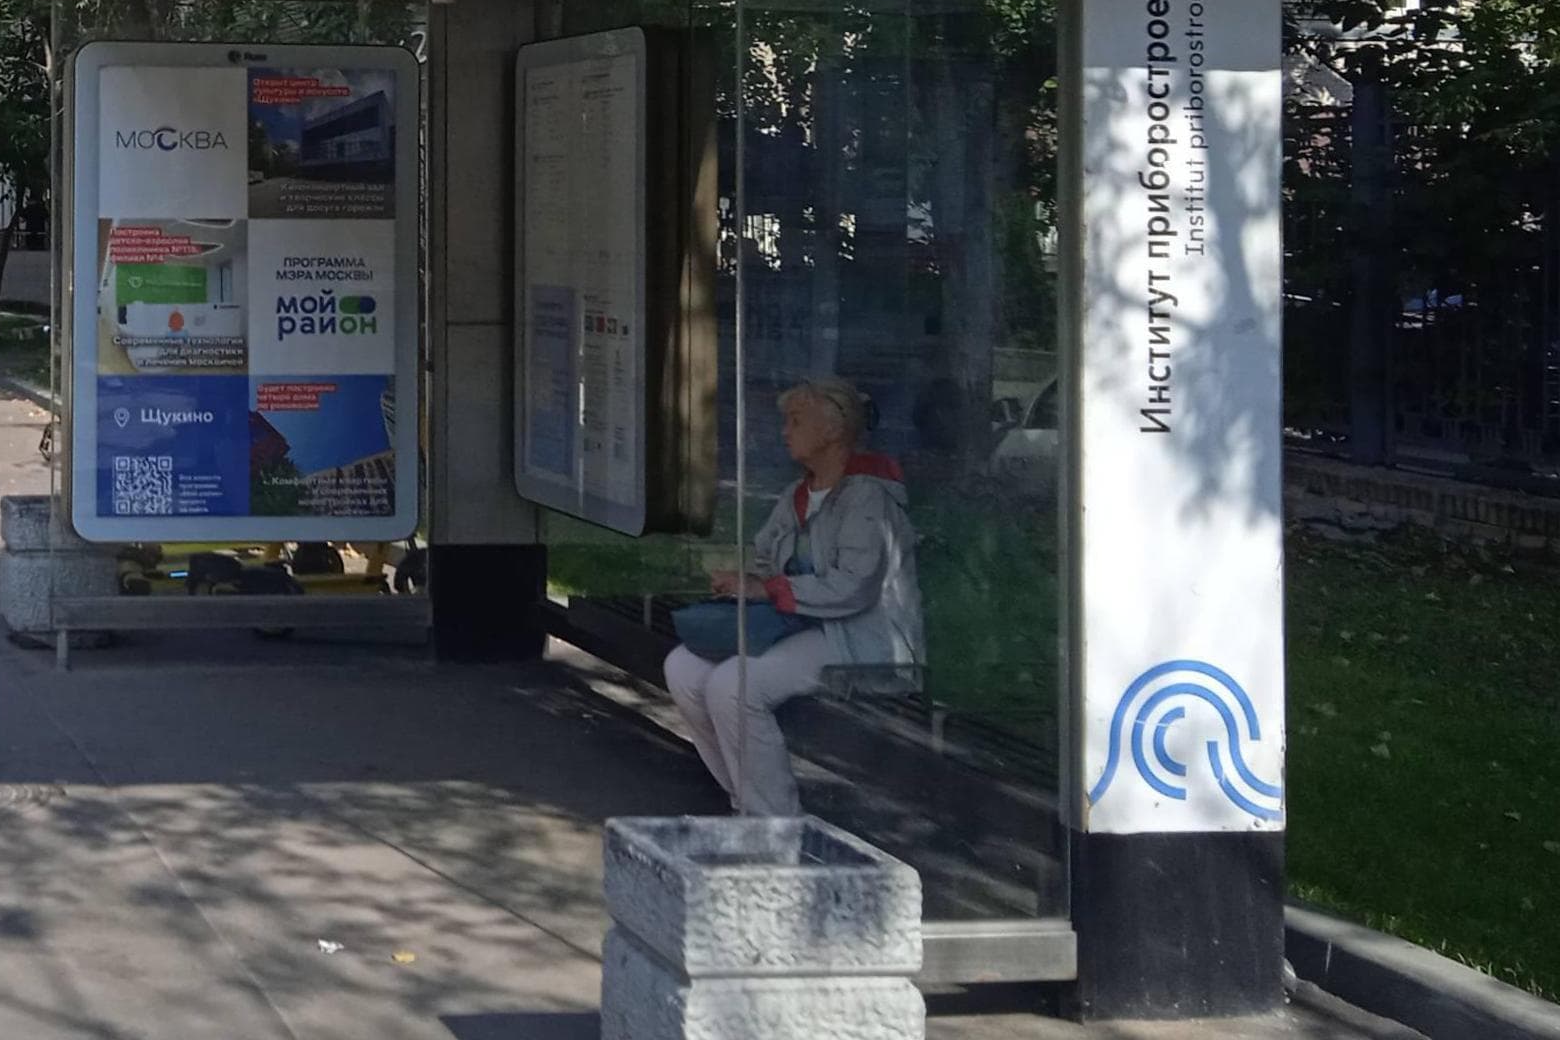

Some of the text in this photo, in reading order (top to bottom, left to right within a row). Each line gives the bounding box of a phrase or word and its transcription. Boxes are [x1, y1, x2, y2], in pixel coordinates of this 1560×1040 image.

[115, 126, 229, 151] МОСКВА
[1184, 159, 1206, 256] Institut
[283, 256, 366, 268] ПРОГРАММА
[276, 269, 374, 281] МЭРА МОСКВЫ
[276, 288, 337, 315] мой
[1141, 264, 1178, 434] Институт
[140, 408, 214, 426] Щукино
